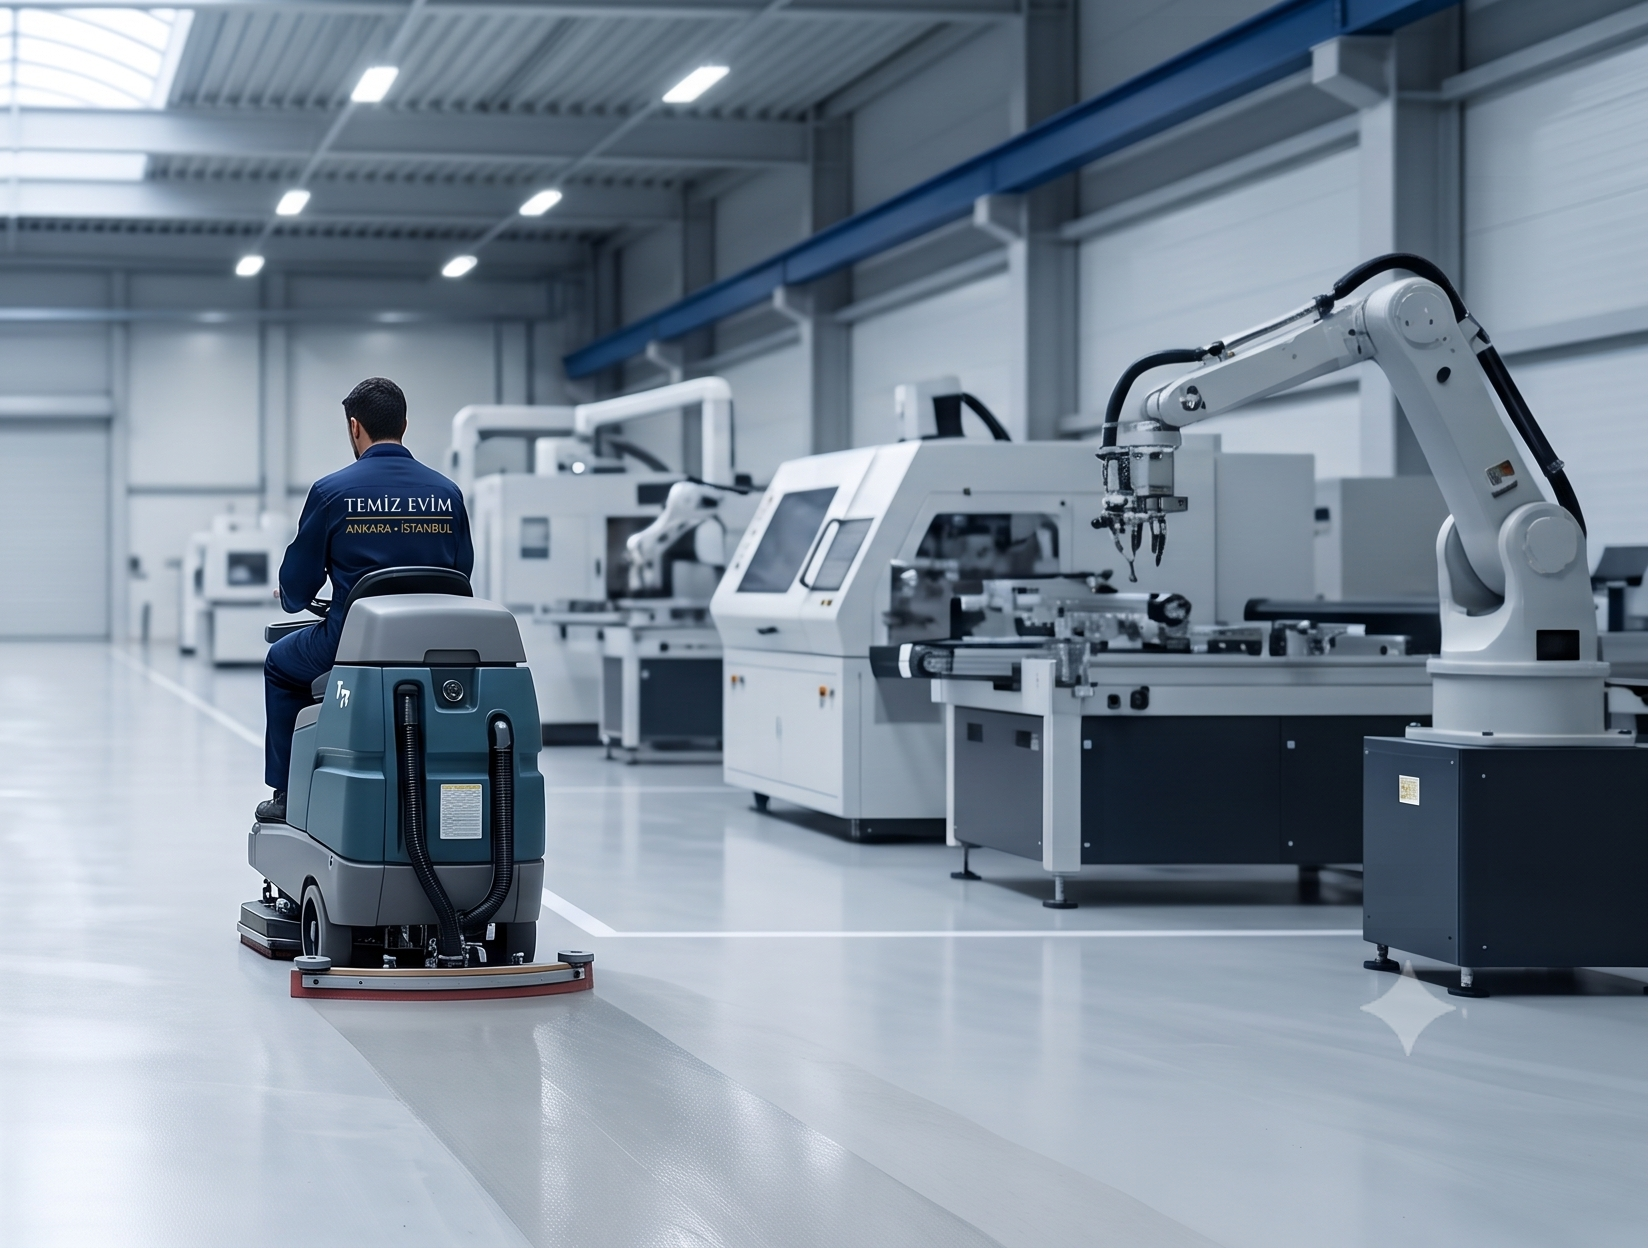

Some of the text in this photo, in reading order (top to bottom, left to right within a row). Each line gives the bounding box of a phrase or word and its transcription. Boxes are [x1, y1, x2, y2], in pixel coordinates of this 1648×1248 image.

[344, 494, 453, 512] TEMİZ EVİM
[345, 520, 453, 534] ANKARA İSTANBUL
